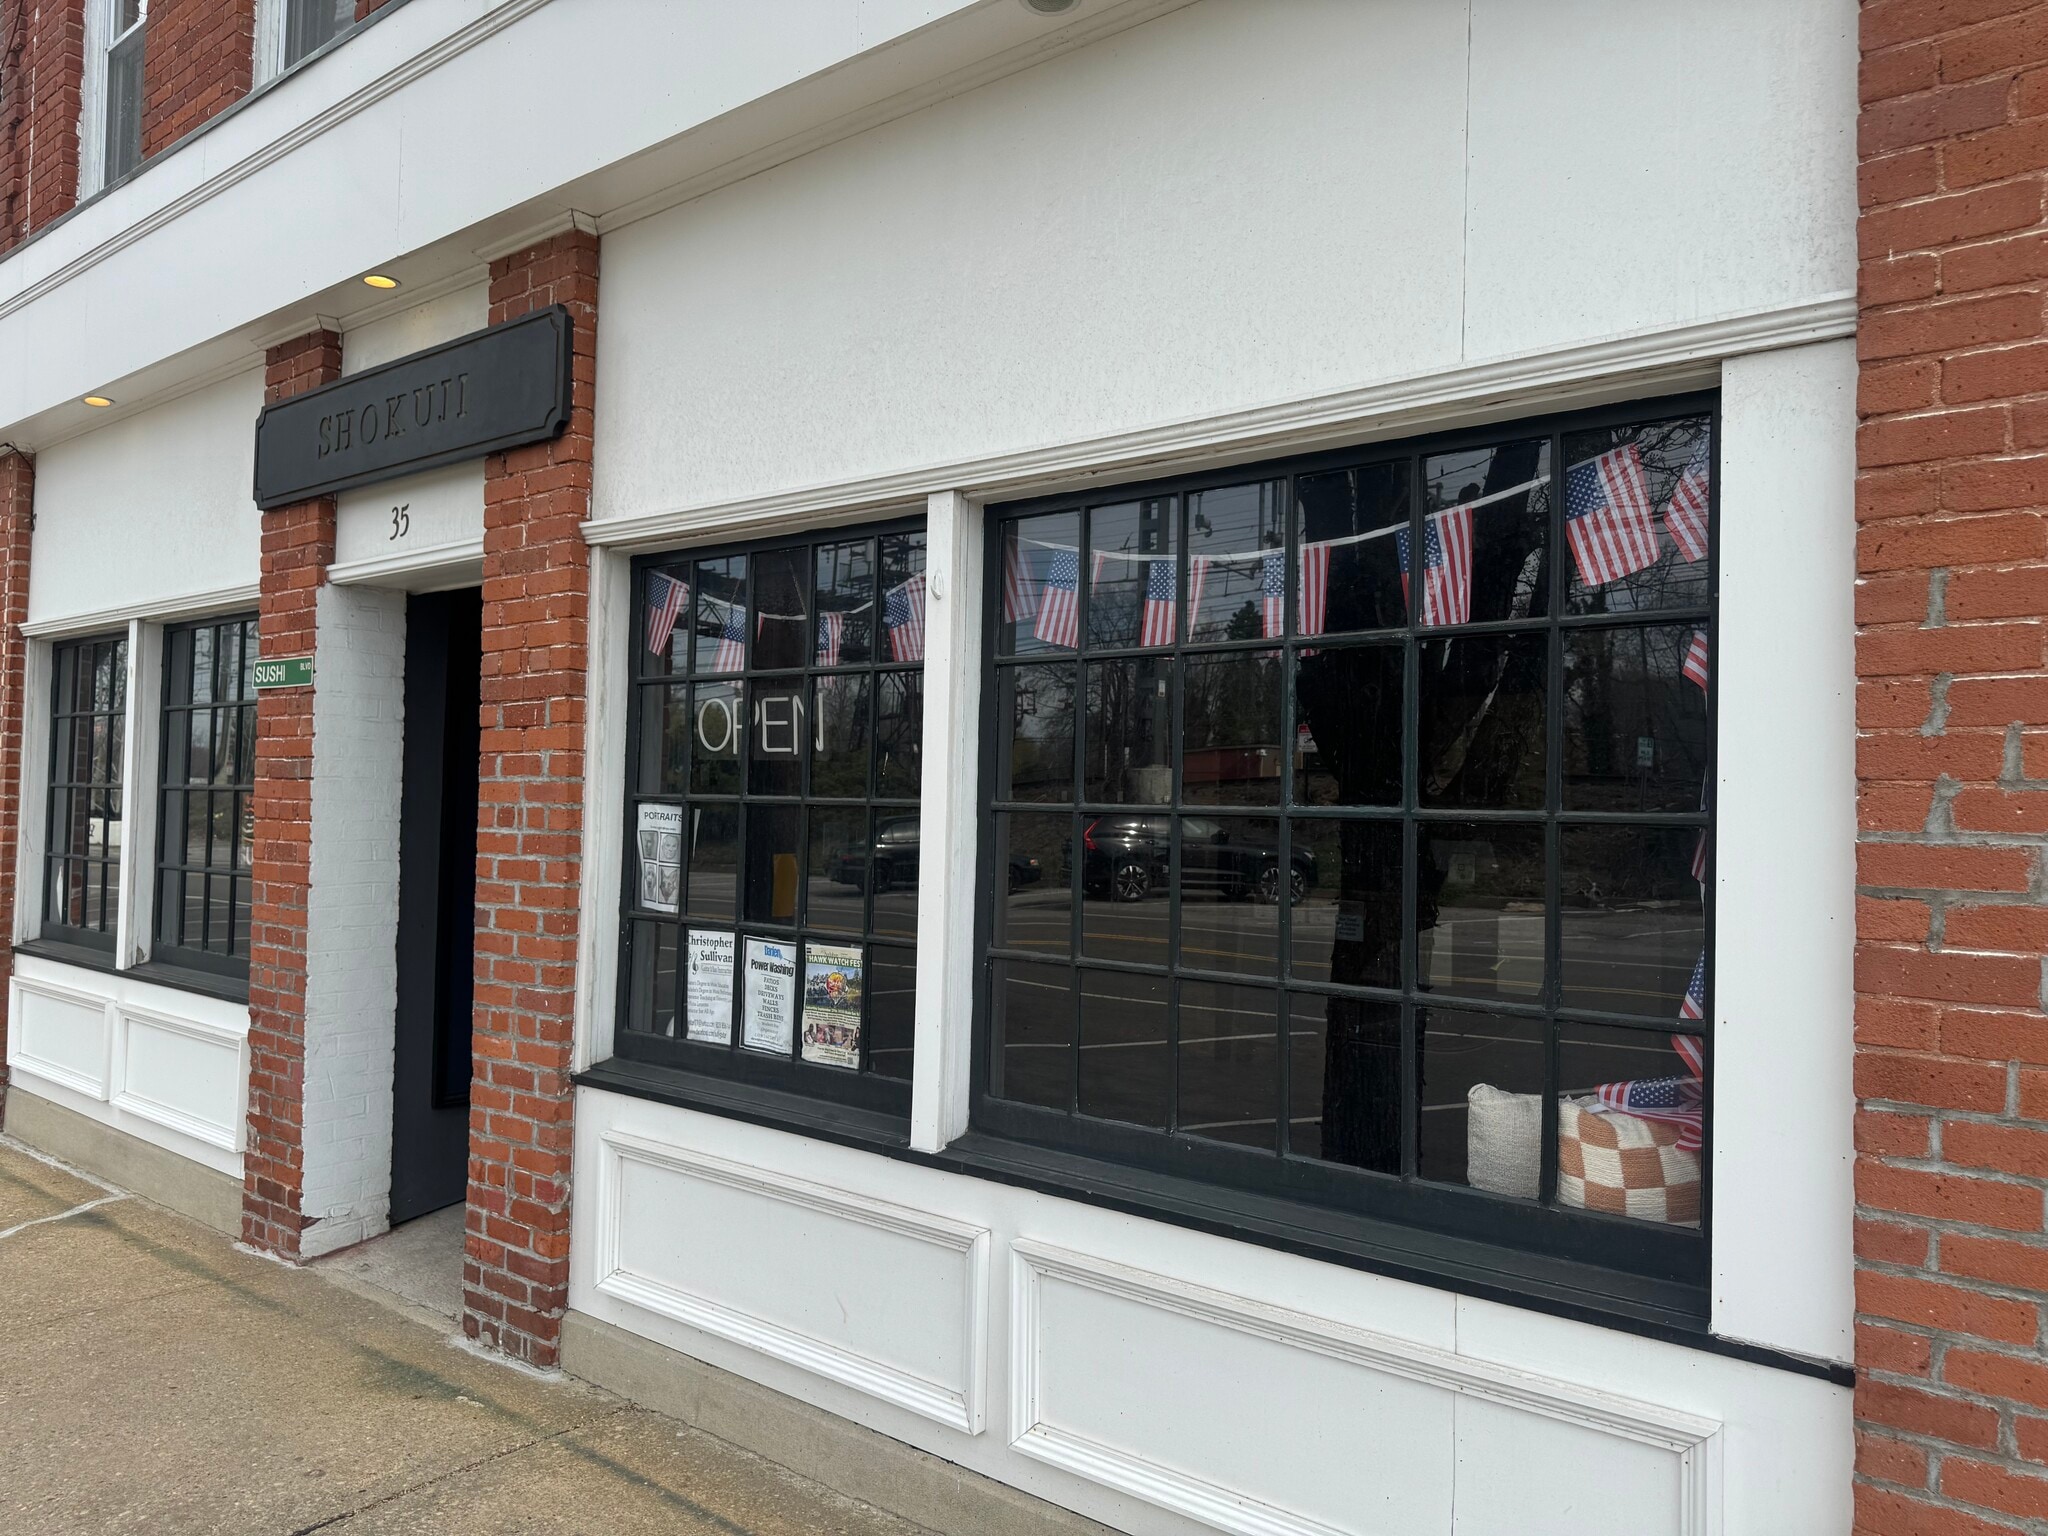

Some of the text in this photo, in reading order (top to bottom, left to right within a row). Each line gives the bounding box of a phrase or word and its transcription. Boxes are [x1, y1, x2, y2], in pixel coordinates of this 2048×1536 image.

[318, 373, 468, 459] SHOKUJI
[390, 504, 410, 541] 35
[255, 662, 311, 683] SUSHI BLVD
[698, 692, 824, 755] OPEN
[689, 934, 733, 950] hristopher
[700, 950, 733, 963] Sullivan
[809, 955, 828, 964] HAWK
[828, 957, 849, 967] WATCH
[751, 958, 794, 978] Power Washing
[763, 977, 780, 986] PATIOS
[757, 989, 785, 1001] DRIVEWAYS
[762, 998, 779, 1007] WALLS
[757, 1011, 773, 1020] TRASH
